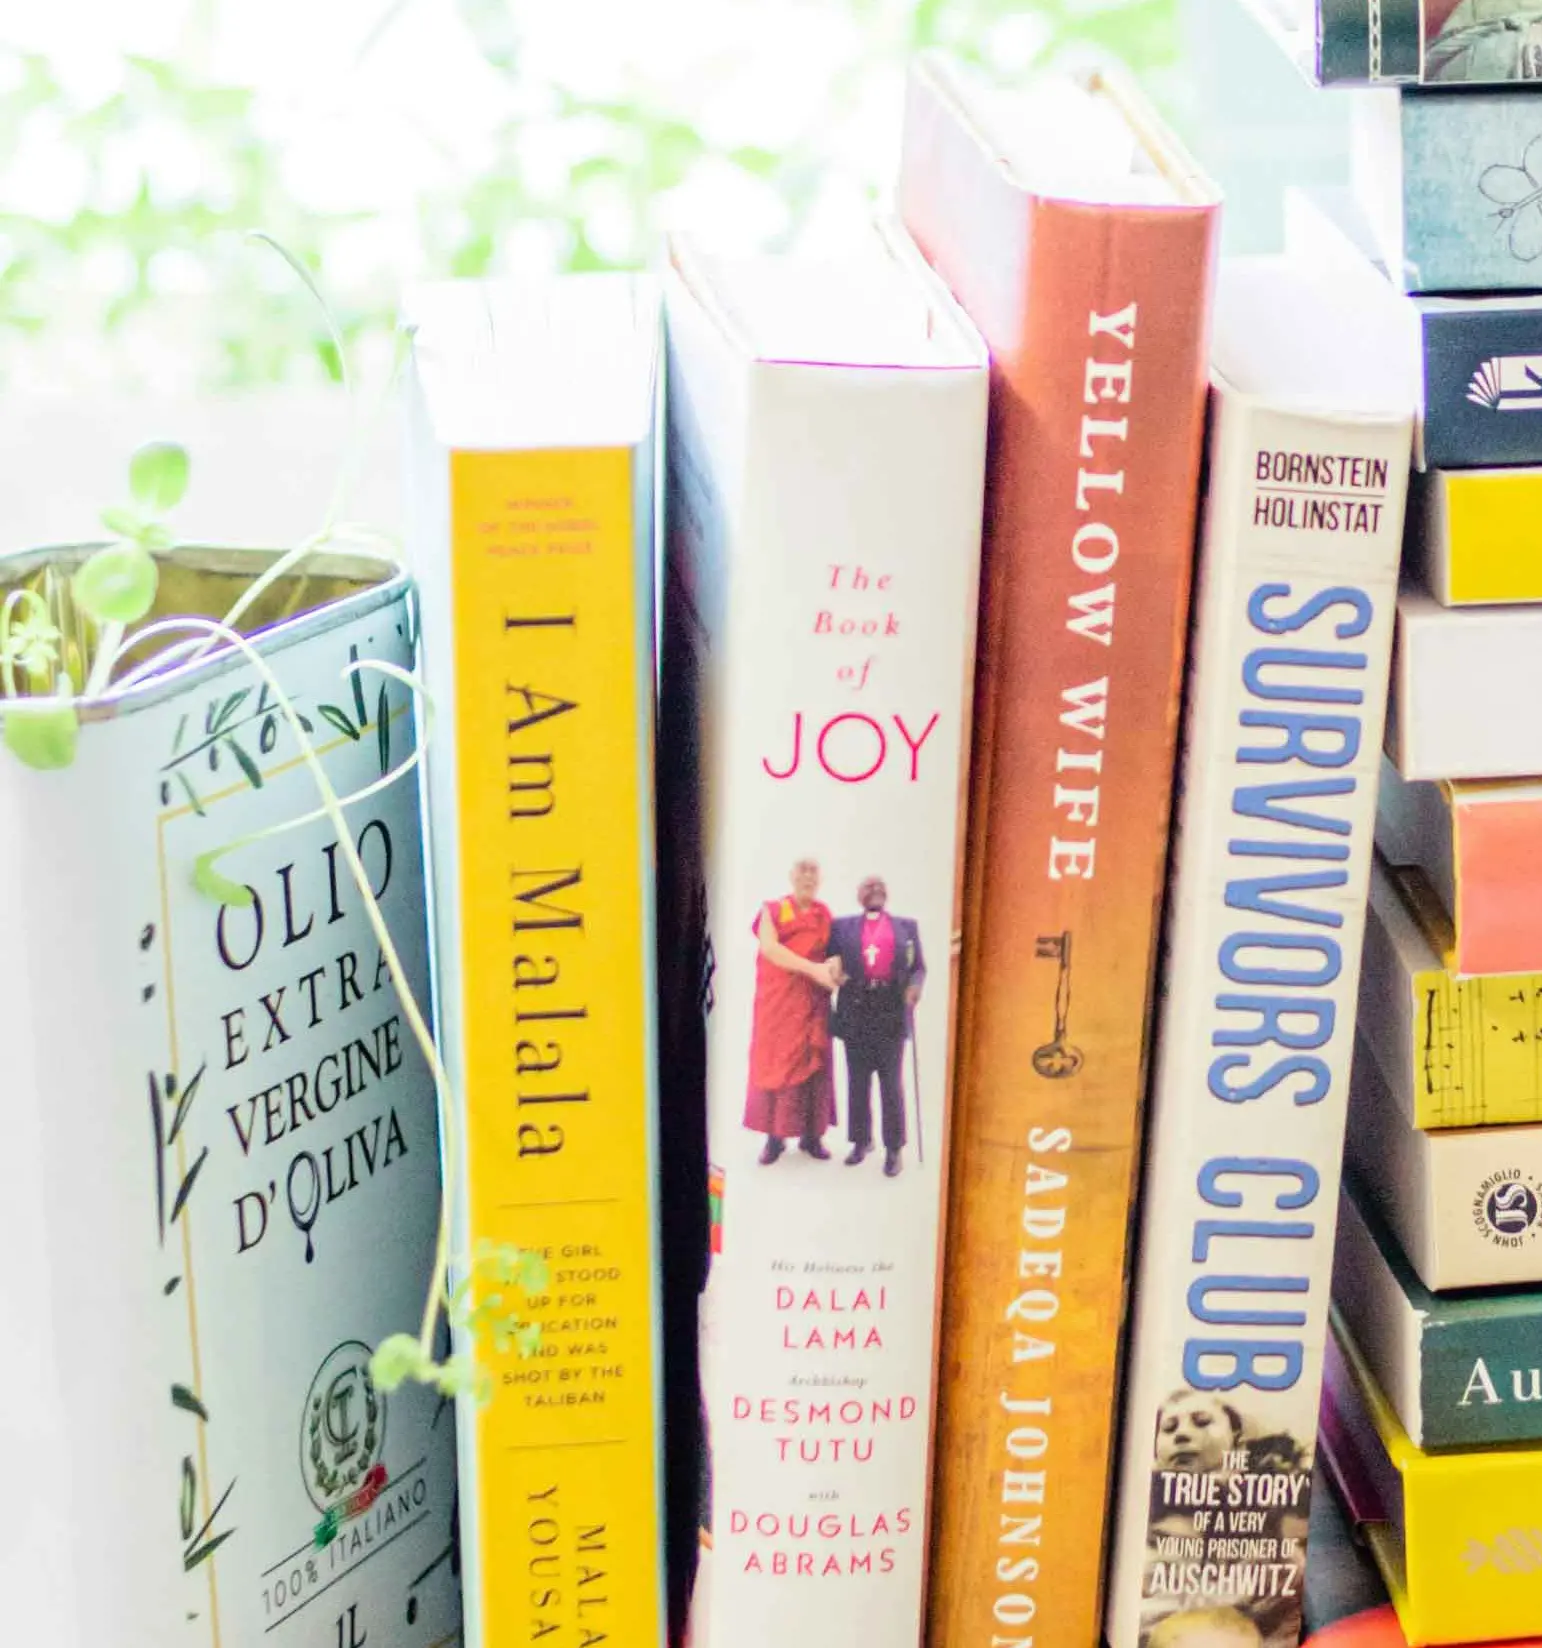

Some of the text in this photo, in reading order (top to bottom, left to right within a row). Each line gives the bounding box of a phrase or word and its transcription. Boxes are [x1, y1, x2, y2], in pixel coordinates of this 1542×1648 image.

[1256, 450, 1388, 488] BORNSTEIN
[1253, 497, 1383, 534] HOLINSTAT
[829, 564, 892, 591] The
[1047, 302, 1138, 881] YELLOW WIFE
[504, 606, 577, 636] I
[813, 610, 901, 636] Book
[836, 655, 876, 690] of
[505, 680, 580, 822] Am
[762, 711, 940, 783] JOY
[216, 819, 392, 970] OLIO
[1182, 583, 1374, 1391] SURVIVORS CLUB
[221, 948, 396, 1071] EXTRA
[511, 862, 591, 1160] Malala
[226, 1015, 403, 1156] VERGINE
[562, 1245, 602, 1258] GIRL
[1006, 1125, 1073, 1363] SADEQA
[1492, 1234, 1523, 1248] JOHN
[556, 1267, 621, 1283] STOOD
[527, 1294, 596, 1309] UP FOR
[776, 1285, 887, 1312] DALAI
[568, 1344, 608, 1355] WAS
[783, 1325, 884, 1350] LAMA
[503, 1365, 623, 1384] SHOT BY THE
[524, 1391, 605, 1407] TALIBAN
[733, 1396, 917, 1425] DESMOND
[775, 1438, 874, 1463] TUTU
[1222, 1451, 1251, 1470] THE
[1161, 1472, 1303, 1507] TRUE STORY
[731, 1508, 912, 1539] DOUGLAS
[1193, 1511, 1267, 1533] OF A VERY
[262, 1476, 428, 1615] 100% ITALIANO
[1156, 1536, 1299, 1558] YOUNG PRISONER OF
[527, 1484, 562, 1641] YOUSA
[744, 1548, 896, 1577] ABRAMS
[1150, 1562, 1297, 1597] AUSCHWITZ
